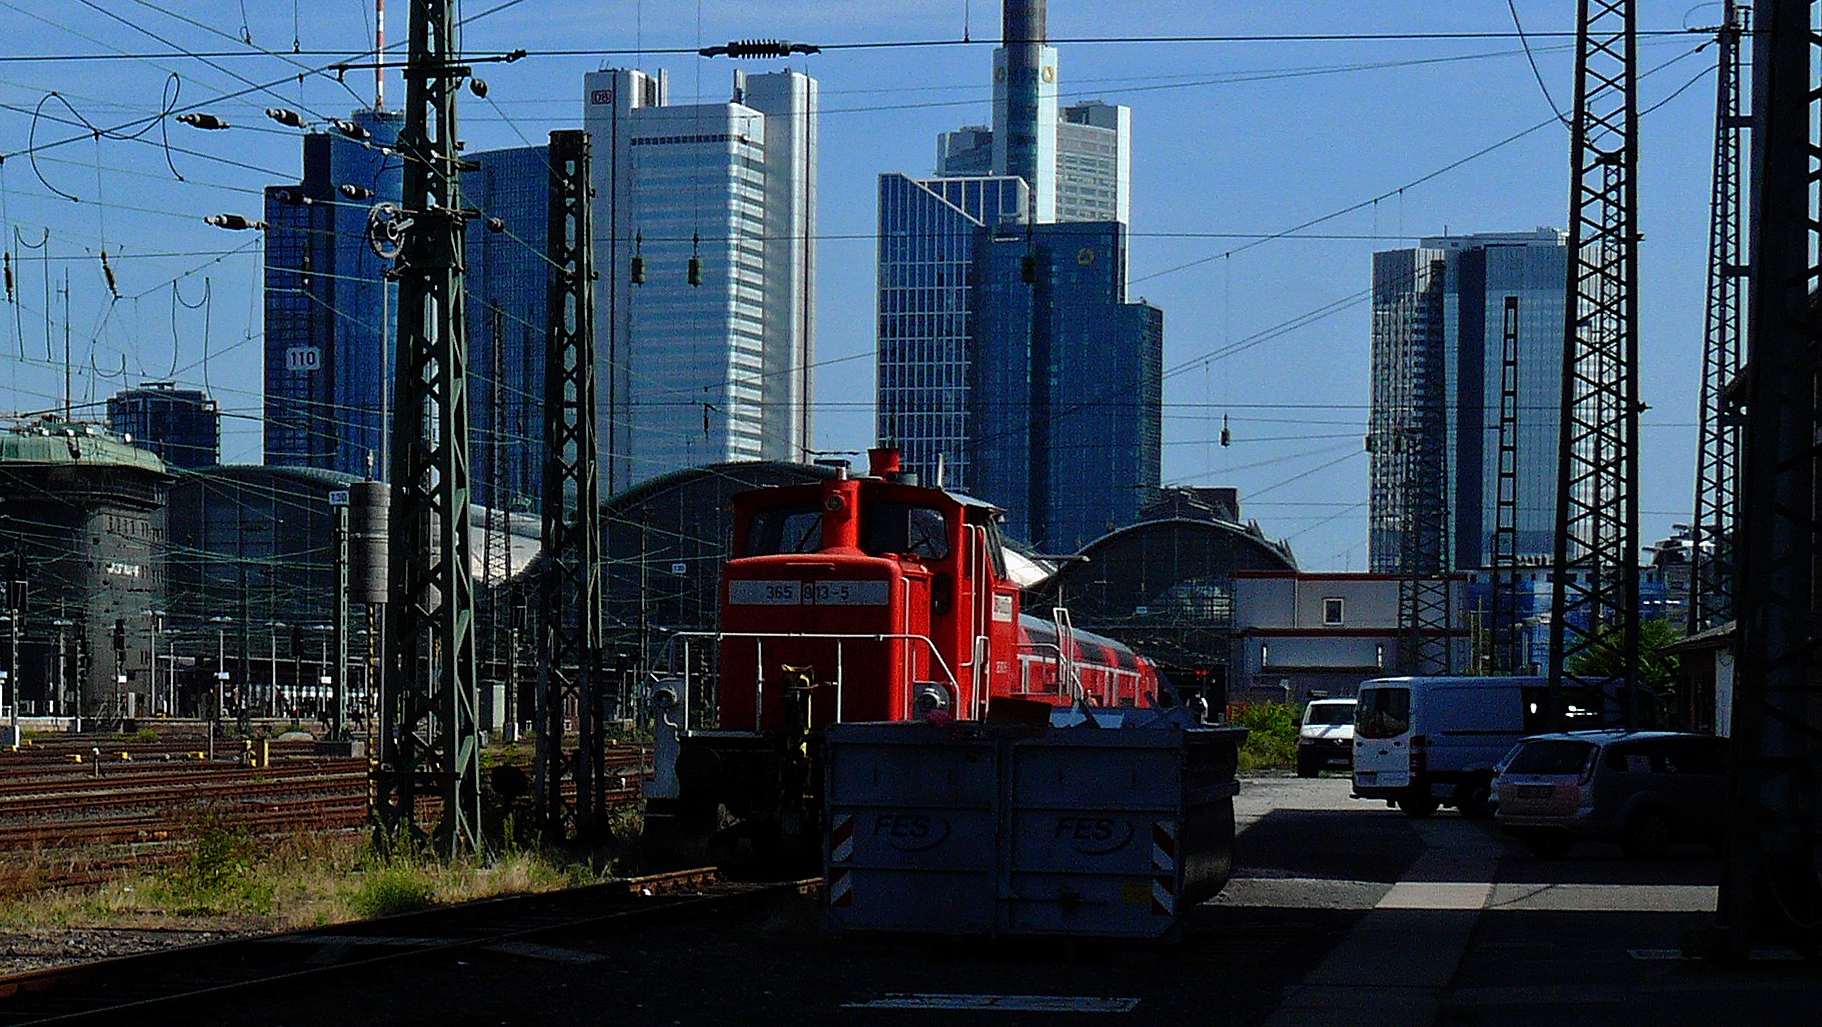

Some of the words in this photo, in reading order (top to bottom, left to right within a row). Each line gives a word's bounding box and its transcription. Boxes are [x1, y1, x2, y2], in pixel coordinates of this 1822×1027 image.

[592, 90, 611, 103] DB
[291, 351, 316, 366] 110
[766, 585, 792, 600] 365
[873, 815, 932, 838] FES
[1055, 817, 1114, 841] FES
